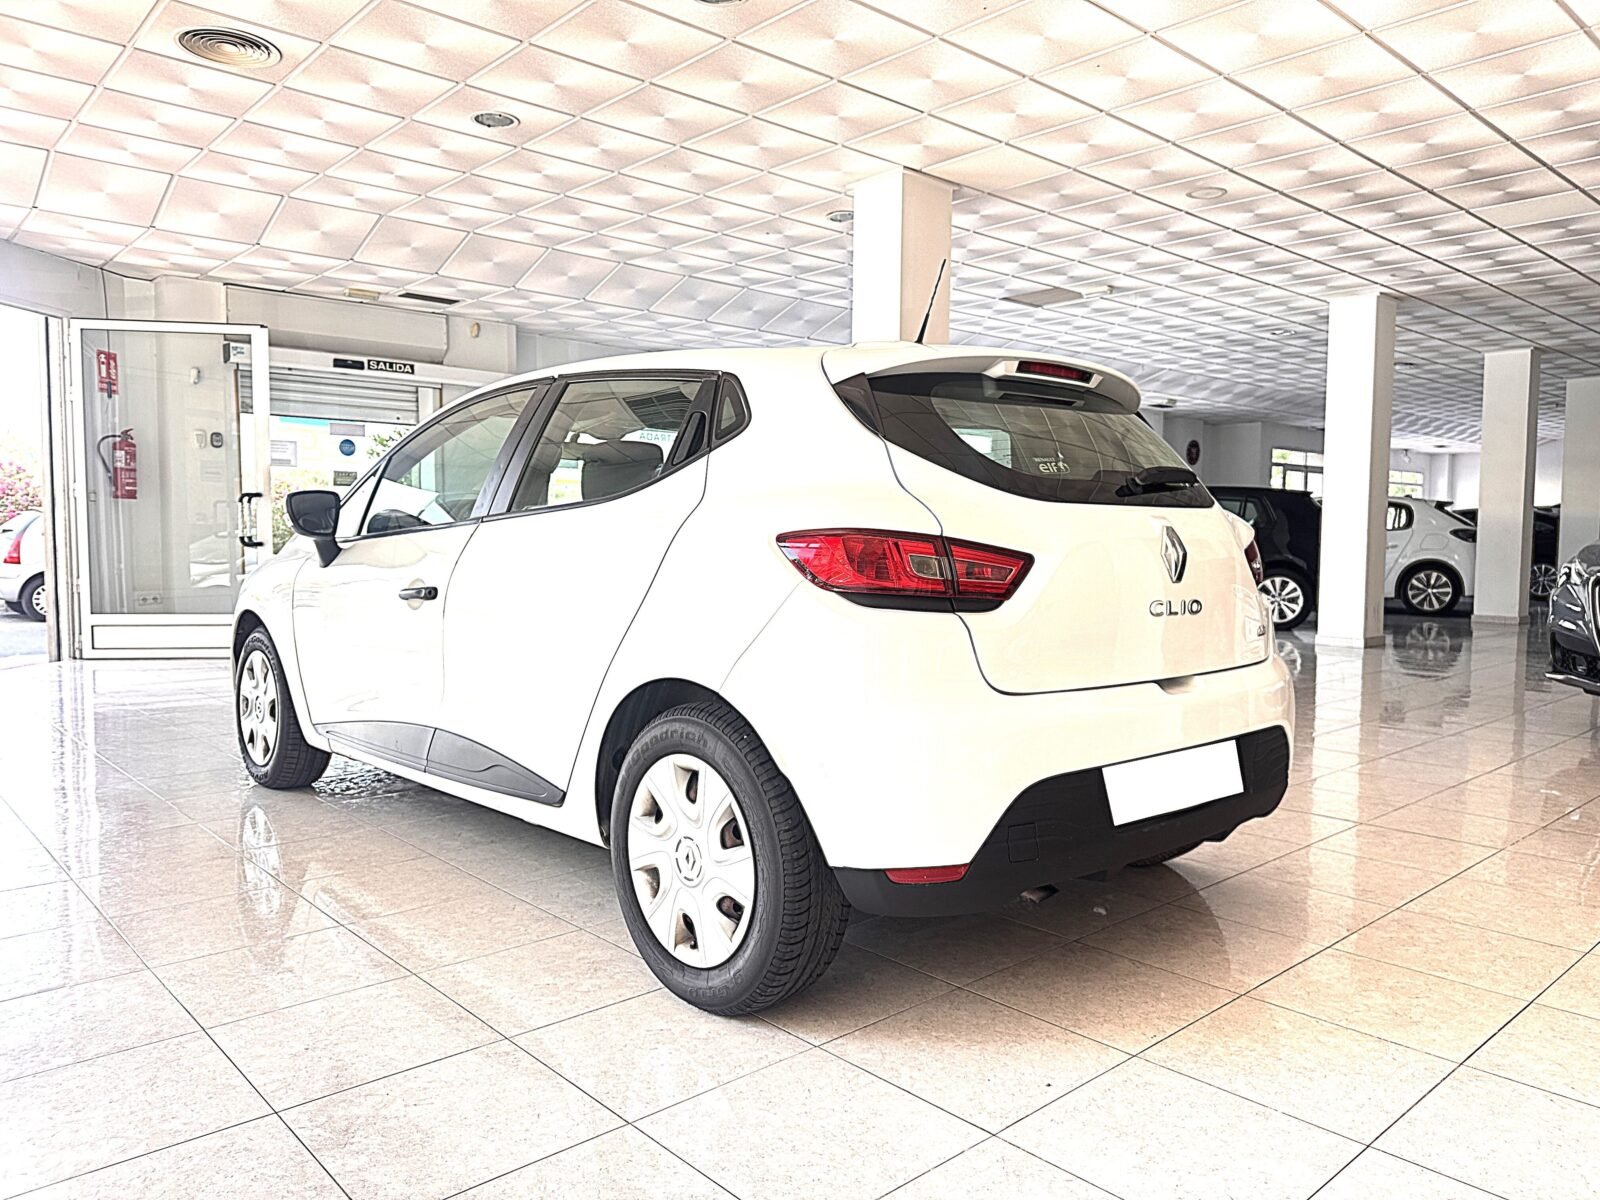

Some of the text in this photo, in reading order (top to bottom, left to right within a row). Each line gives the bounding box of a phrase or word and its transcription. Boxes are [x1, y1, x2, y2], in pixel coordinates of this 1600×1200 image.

[369, 360, 413, 374] SALIDA
[1039, 462, 1058, 473] elf
[1149, 599, 1203, 617] CLIO
